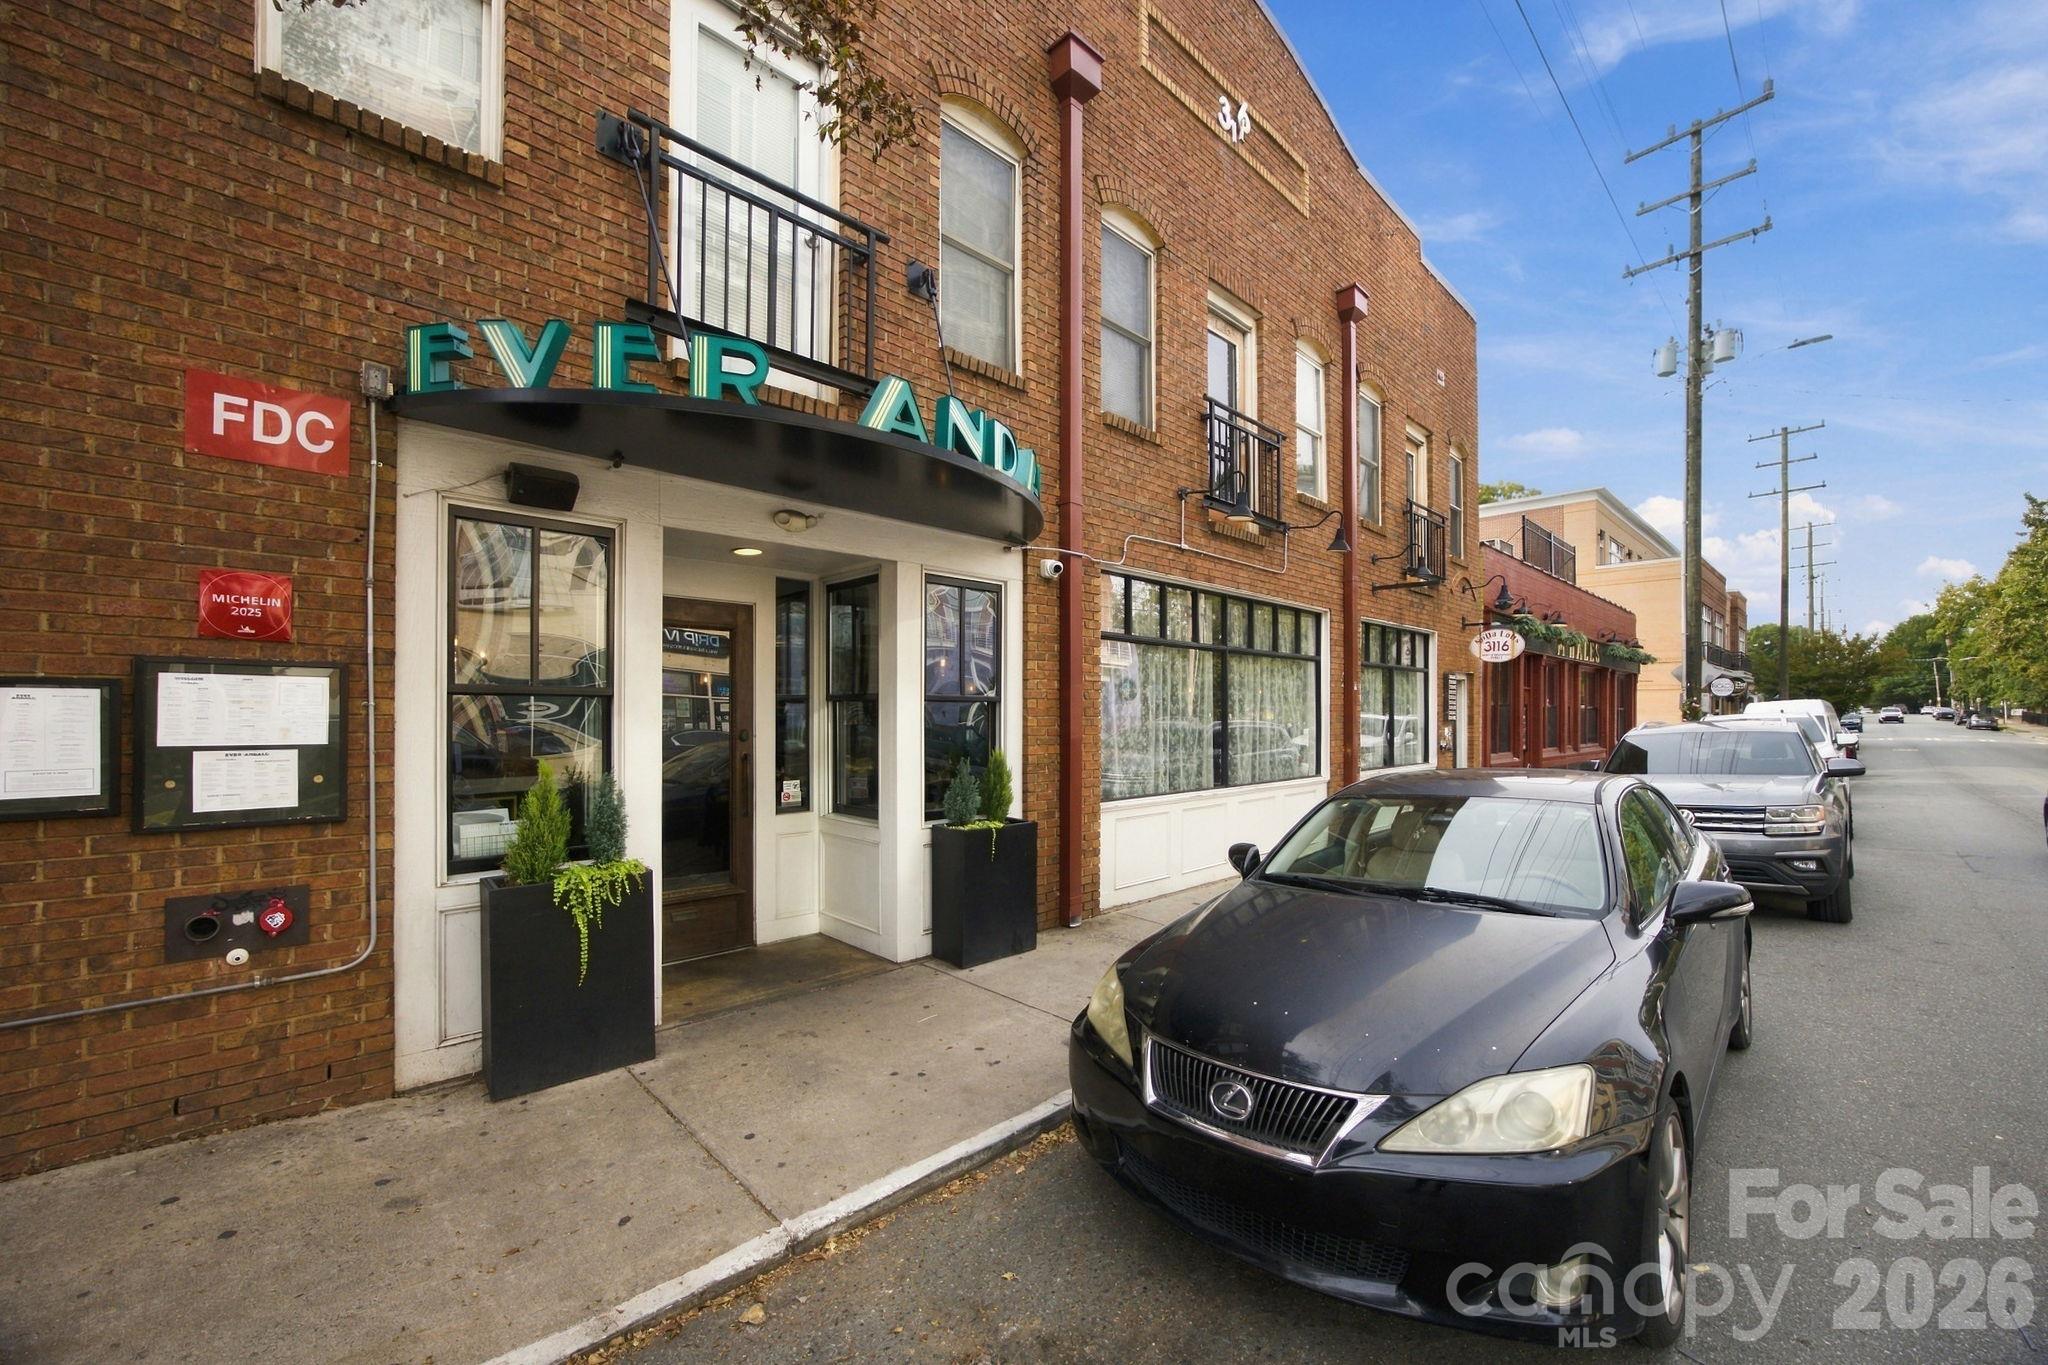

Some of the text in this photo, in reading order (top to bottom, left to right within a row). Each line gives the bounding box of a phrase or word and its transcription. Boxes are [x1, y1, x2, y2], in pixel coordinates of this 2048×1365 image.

[406, 319, 770, 406] EVER
[213, 392, 335, 454] FDC
[212, 594, 281, 607] MICHELIN
[230, 606, 262, 617] 2025
[1484, 640, 1510, 652] 3116
